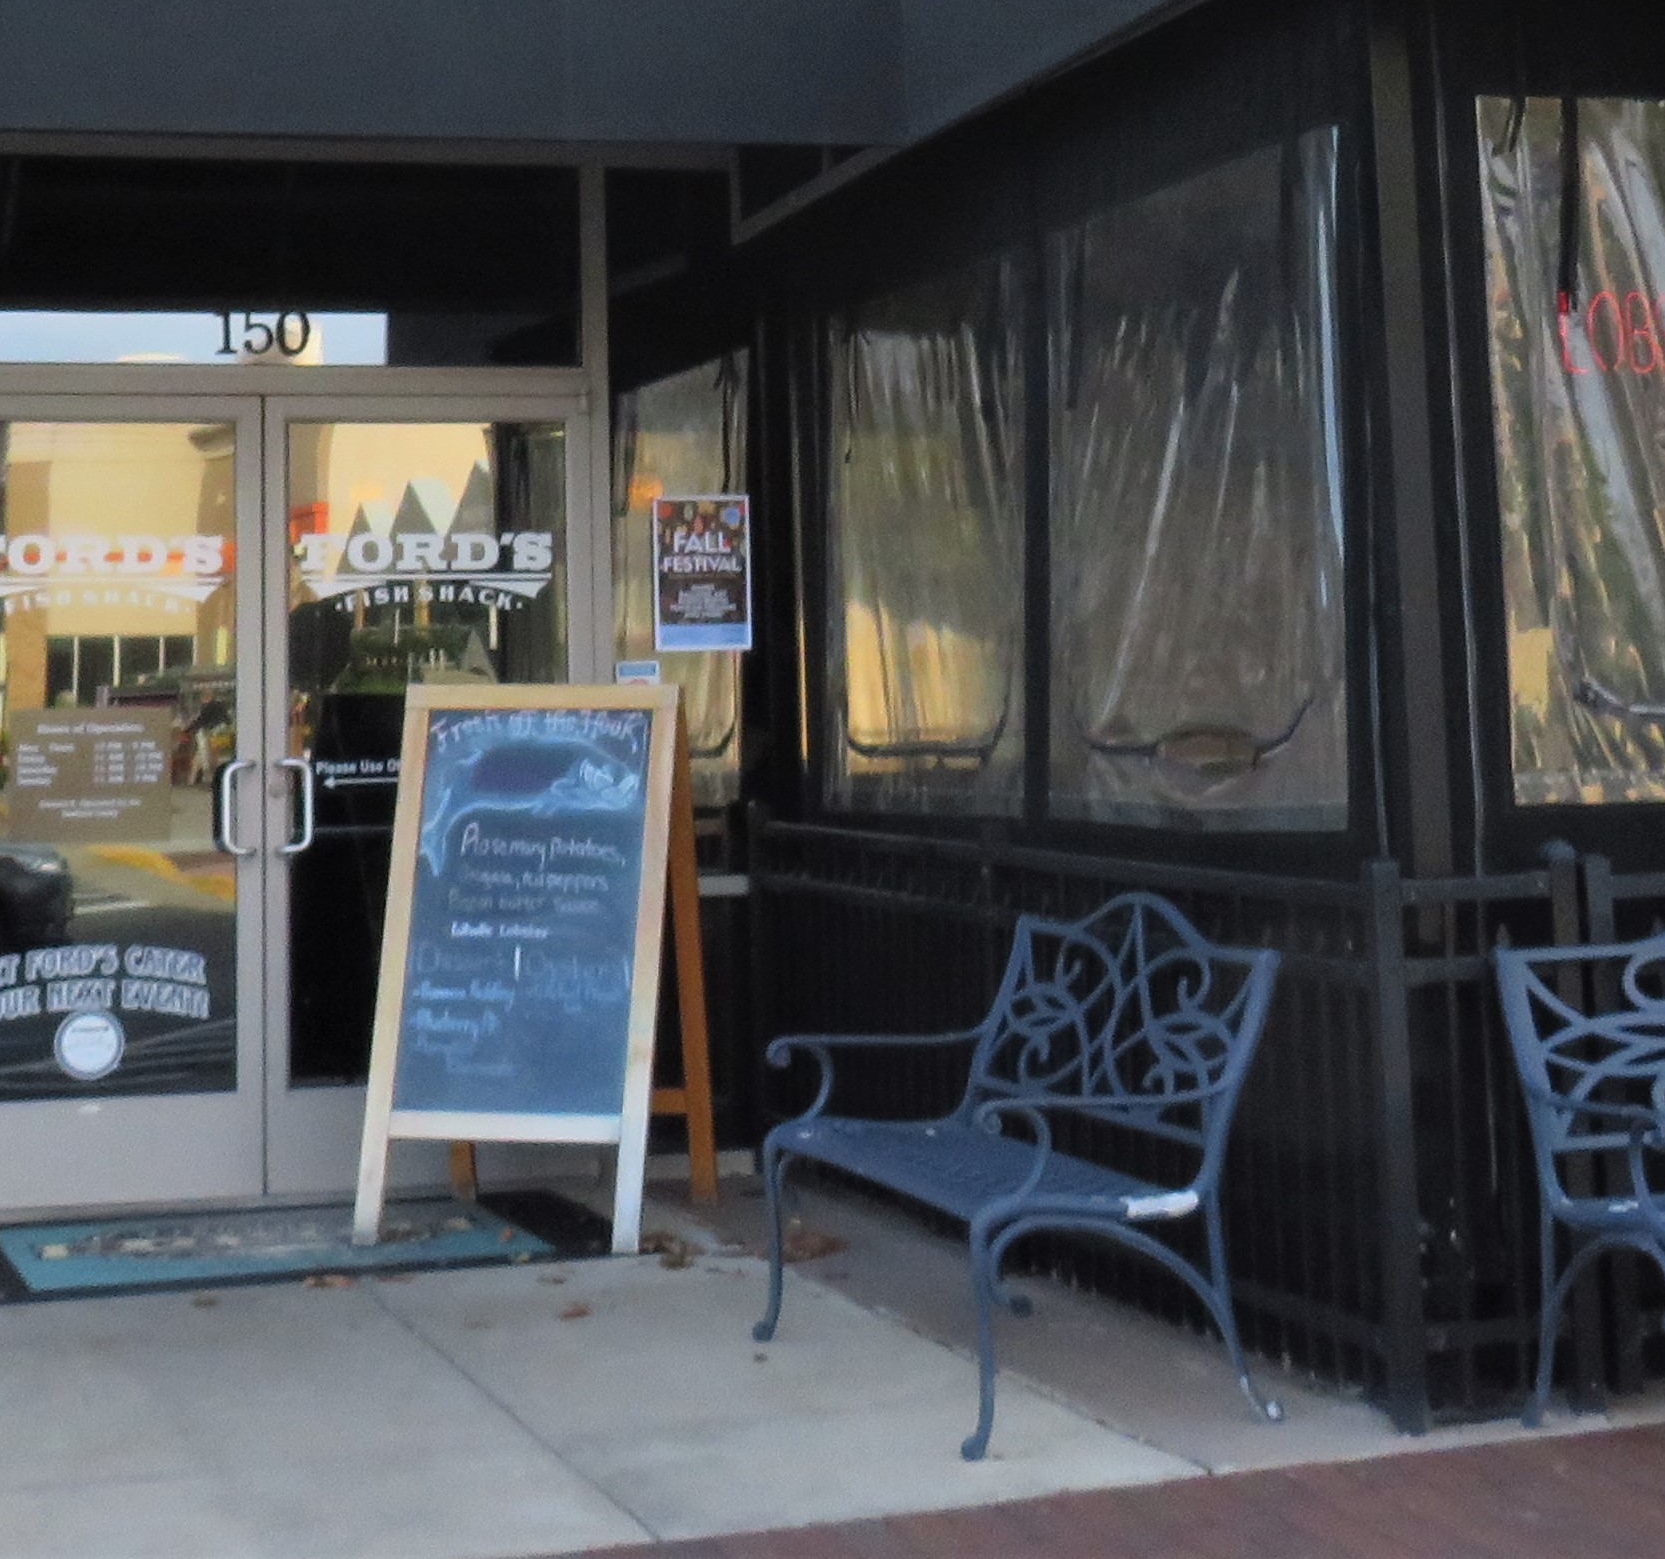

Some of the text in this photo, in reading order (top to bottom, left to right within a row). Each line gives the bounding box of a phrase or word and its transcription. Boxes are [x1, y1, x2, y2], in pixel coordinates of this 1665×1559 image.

[214, 310, 311, 356] 150
[300, 531, 553, 573] FORD'S
[673, 531, 731, 553] FALL
[663, 556, 742, 572] FESTIVAL
[25, 943, 119, 982] FORD'S
[124, 943, 207, 986] CATER
[46, 979, 116, 1013] NEXT
